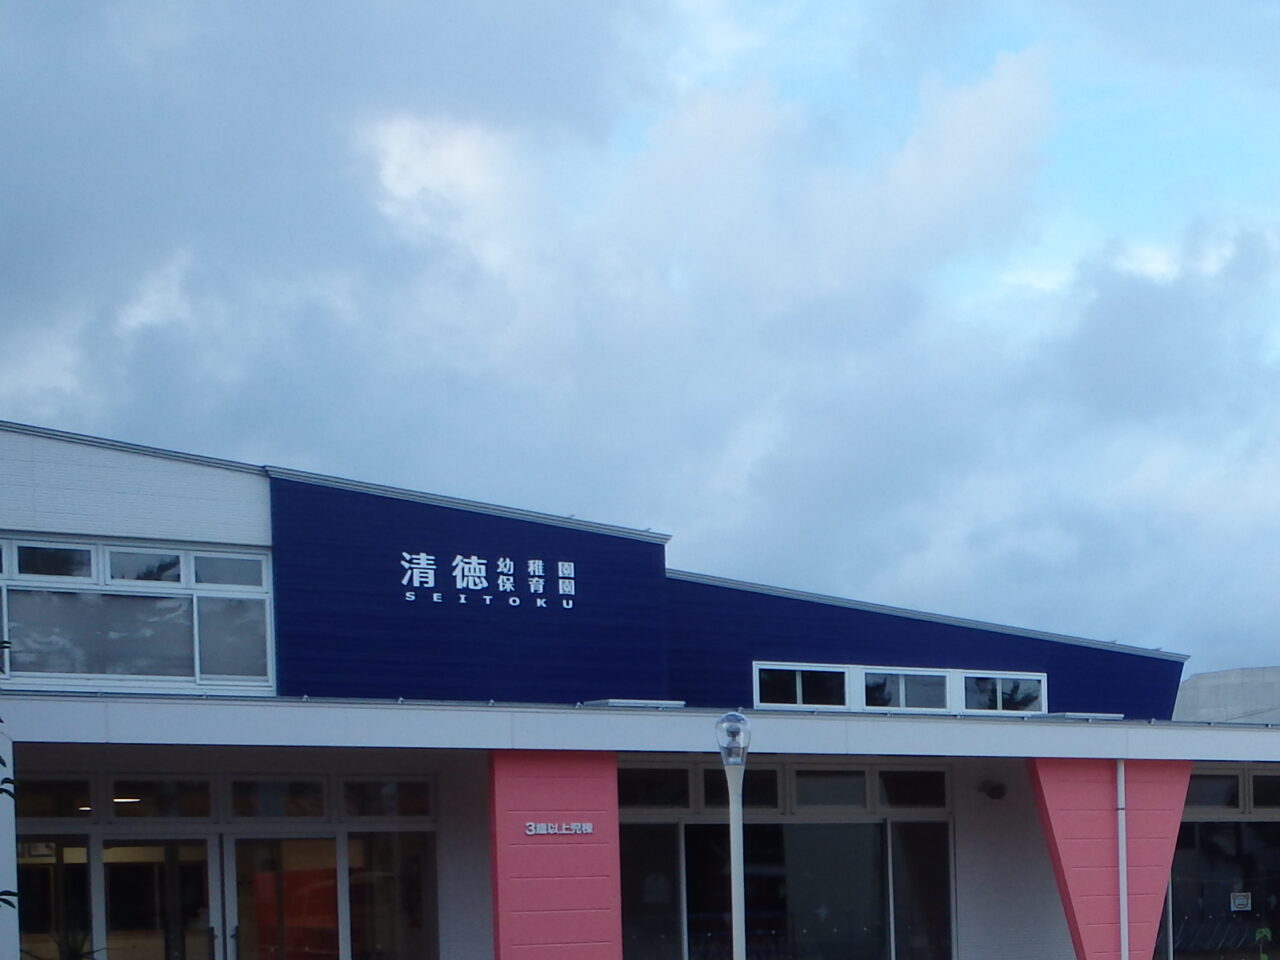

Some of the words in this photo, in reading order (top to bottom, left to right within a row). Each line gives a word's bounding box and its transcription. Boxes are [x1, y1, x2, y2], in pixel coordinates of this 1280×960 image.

[400, 552, 489, 590] 清徳
[497, 557, 575, 578] 幼稚園
[497, 575, 576, 595] 保育園
[405, 591, 573, 609] SEITOKU
